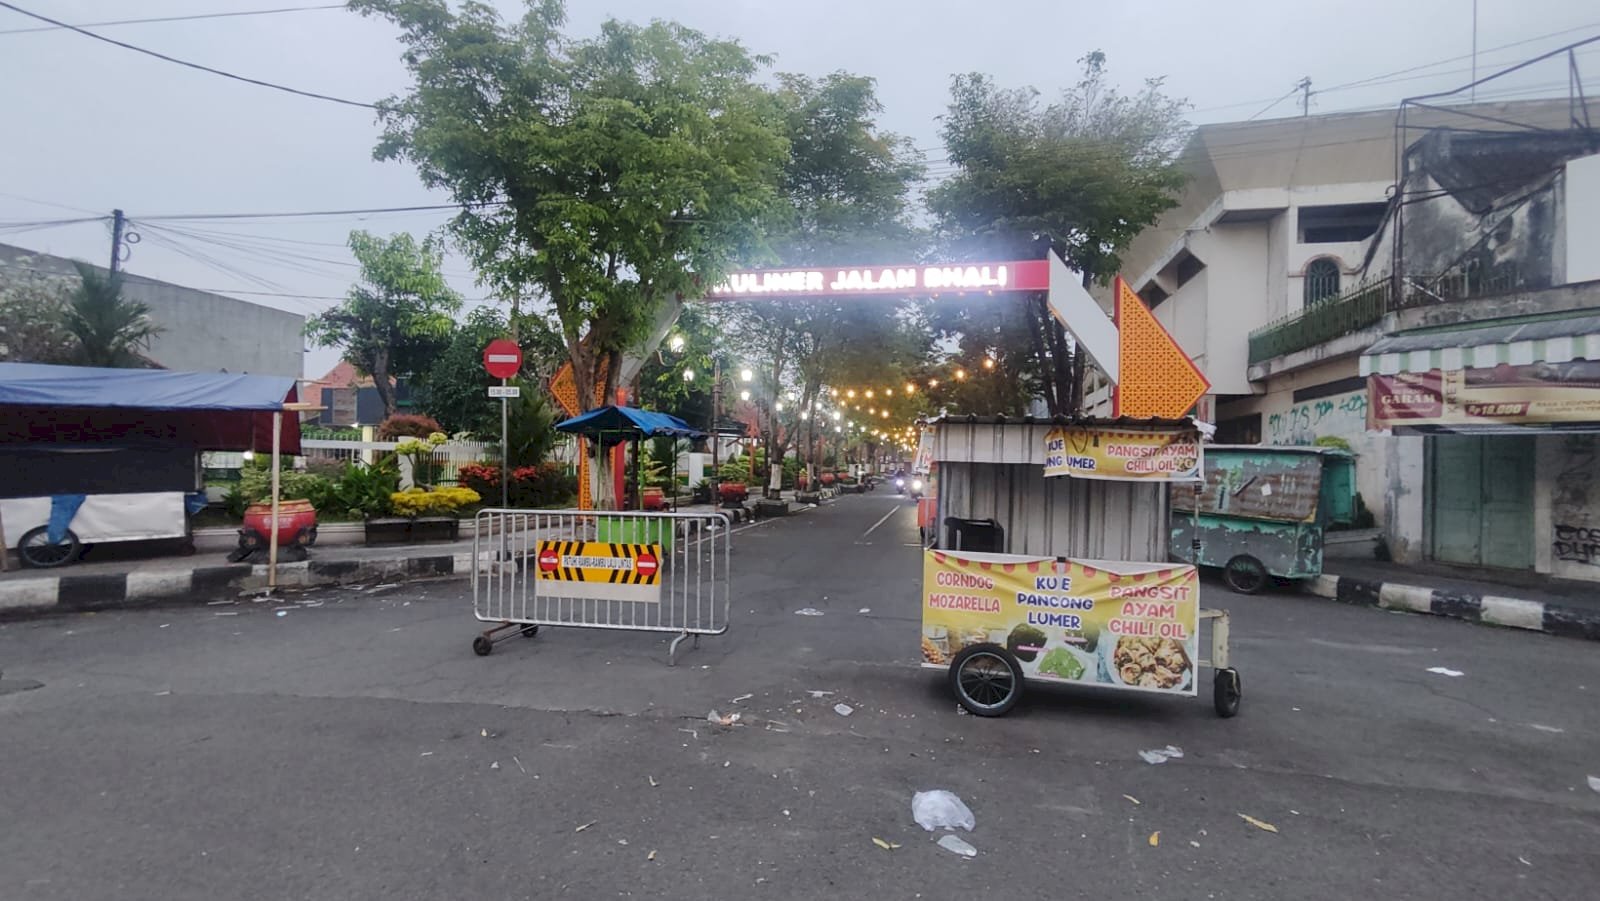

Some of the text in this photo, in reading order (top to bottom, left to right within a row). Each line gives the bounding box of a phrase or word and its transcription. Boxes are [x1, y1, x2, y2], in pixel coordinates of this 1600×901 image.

[830, 268, 916, 290] JALAN
[1107, 444, 1196, 458] PANGSIT AYAM
[1126, 459, 1175, 471] CHILI OIL
[937, 572, 993, 590] CORNDOG
[1036, 577, 1071, 591] KUE
[1017, 593, 1093, 610] PANCONG
[1111, 586, 1190, 600] PANGSIT
[929, 594, 1000, 612] MOZARELLA
[1122, 602, 1175, 618] AYAM
[1028, 612, 1080, 629] LUMER
[1109, 619, 1187, 639] CHILI OIL
